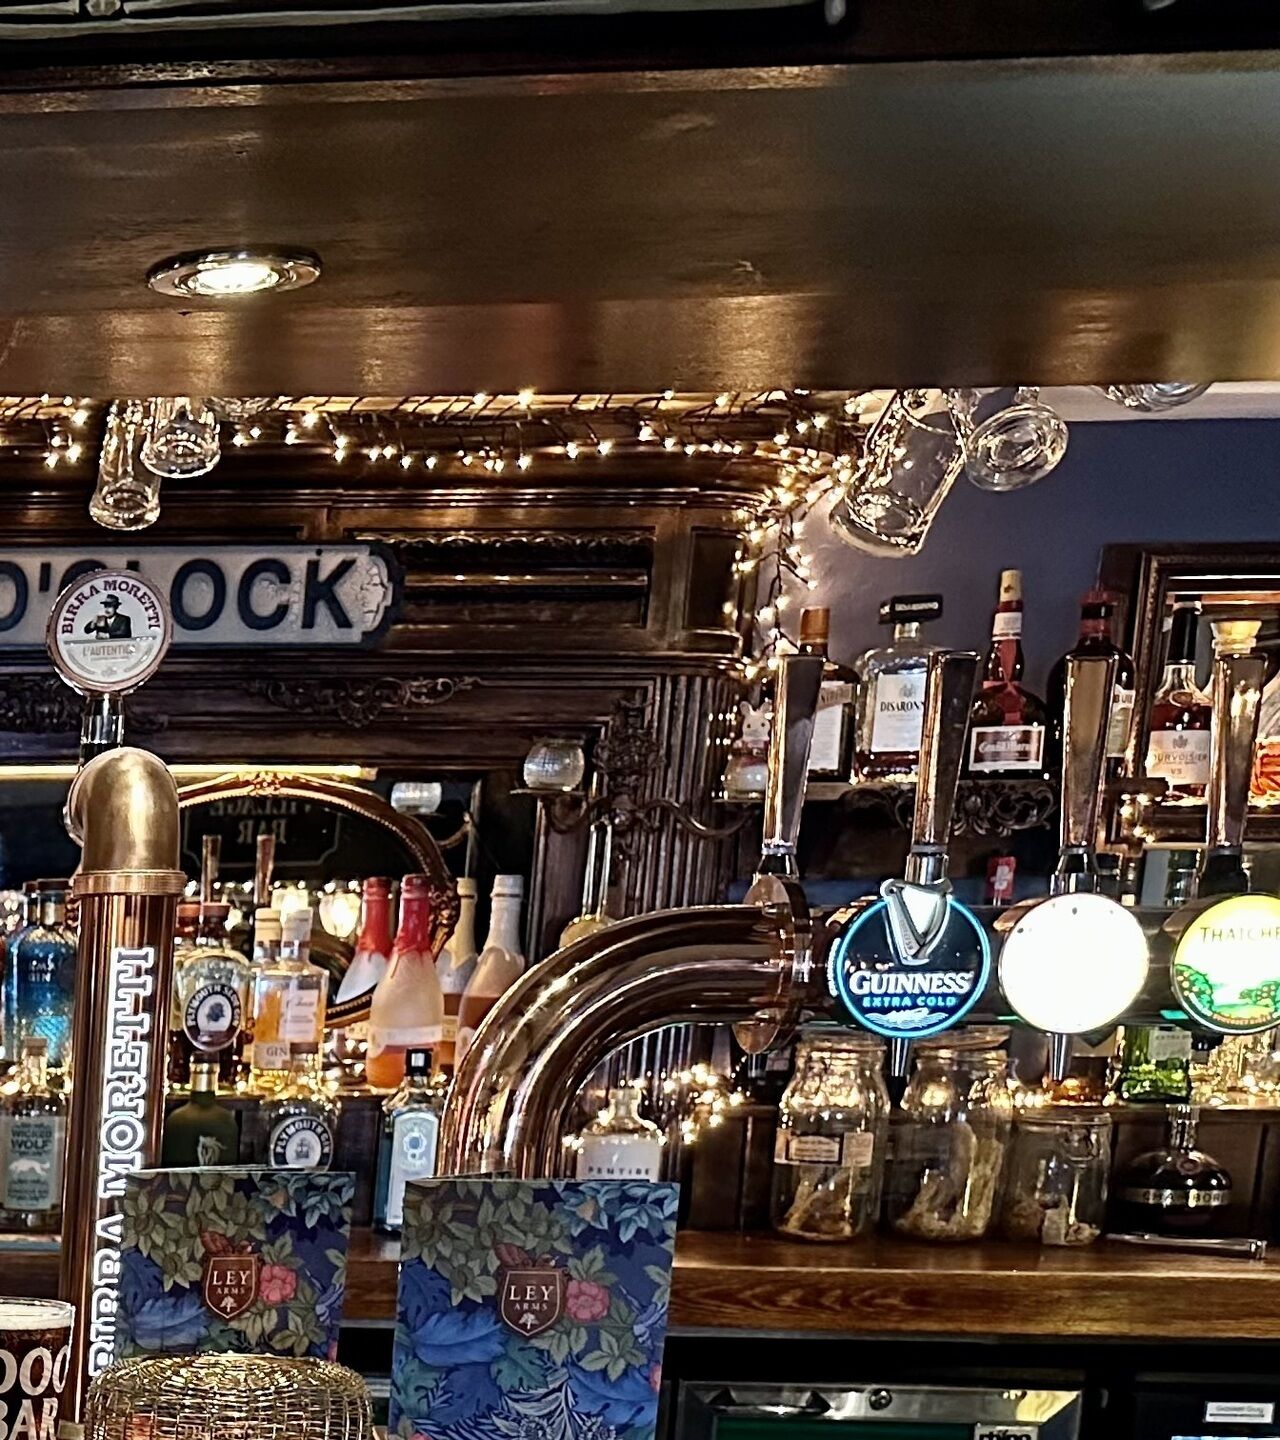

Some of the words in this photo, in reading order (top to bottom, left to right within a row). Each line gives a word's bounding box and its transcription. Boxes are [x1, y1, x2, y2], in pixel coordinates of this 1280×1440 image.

[62, 584, 100, 634] BIRRA
[103, 580, 161, 630] MORETTI
[880, 700, 925, 713] DISARON
[1154, 753, 1208, 762] OURVOISIER
[849, 970, 971, 996] GUINNESS
[862, 996, 913, 1007] EXTRA
[916, 996, 957, 1007] COLD
[98, 946, 154, 1199] MORETTI
[11, 1138, 51, 1150] WOLF
[212, 1270, 251, 1288] LEY
[88, 1213, 125, 1377] BIRRA
[216, 1286, 246, 1296] ARMS
[509, 1285, 556, 1303] LEY
[513, 1302, 549, 1312] ARMS
